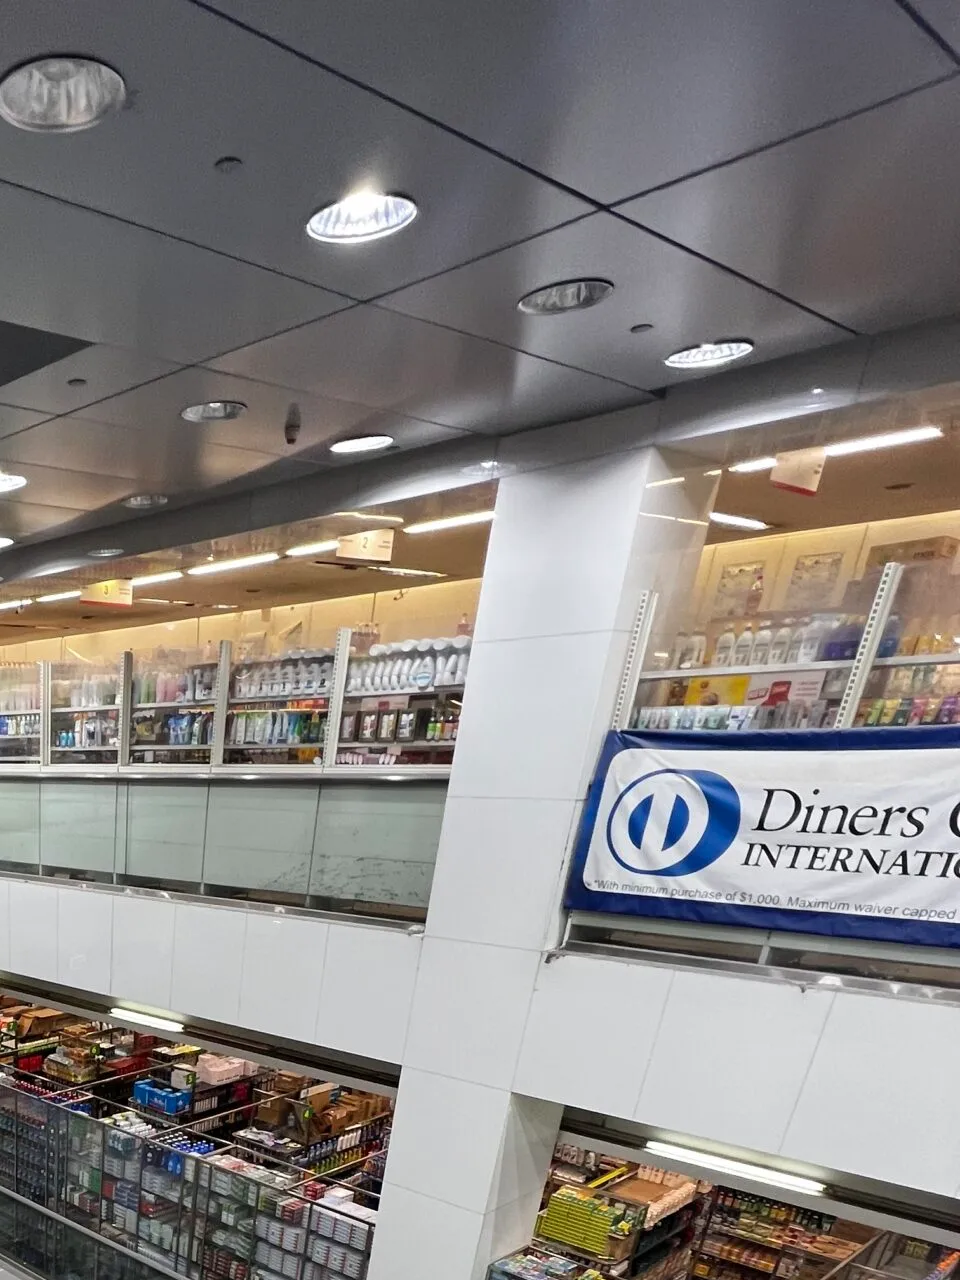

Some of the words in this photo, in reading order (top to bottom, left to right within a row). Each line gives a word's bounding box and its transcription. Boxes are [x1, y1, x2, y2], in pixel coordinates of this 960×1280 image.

[751, 788, 930, 838] Diners
[740, 842, 960, 879] INTERNATI
[621, 882, 668, 895] minimum
[670, 886, 722, 900] purchase
[725, 890, 738, 901] of
[787, 896, 850, 911] Maximum
[854, 904, 899, 916] waiver
[902, 908, 957, 920] capped
